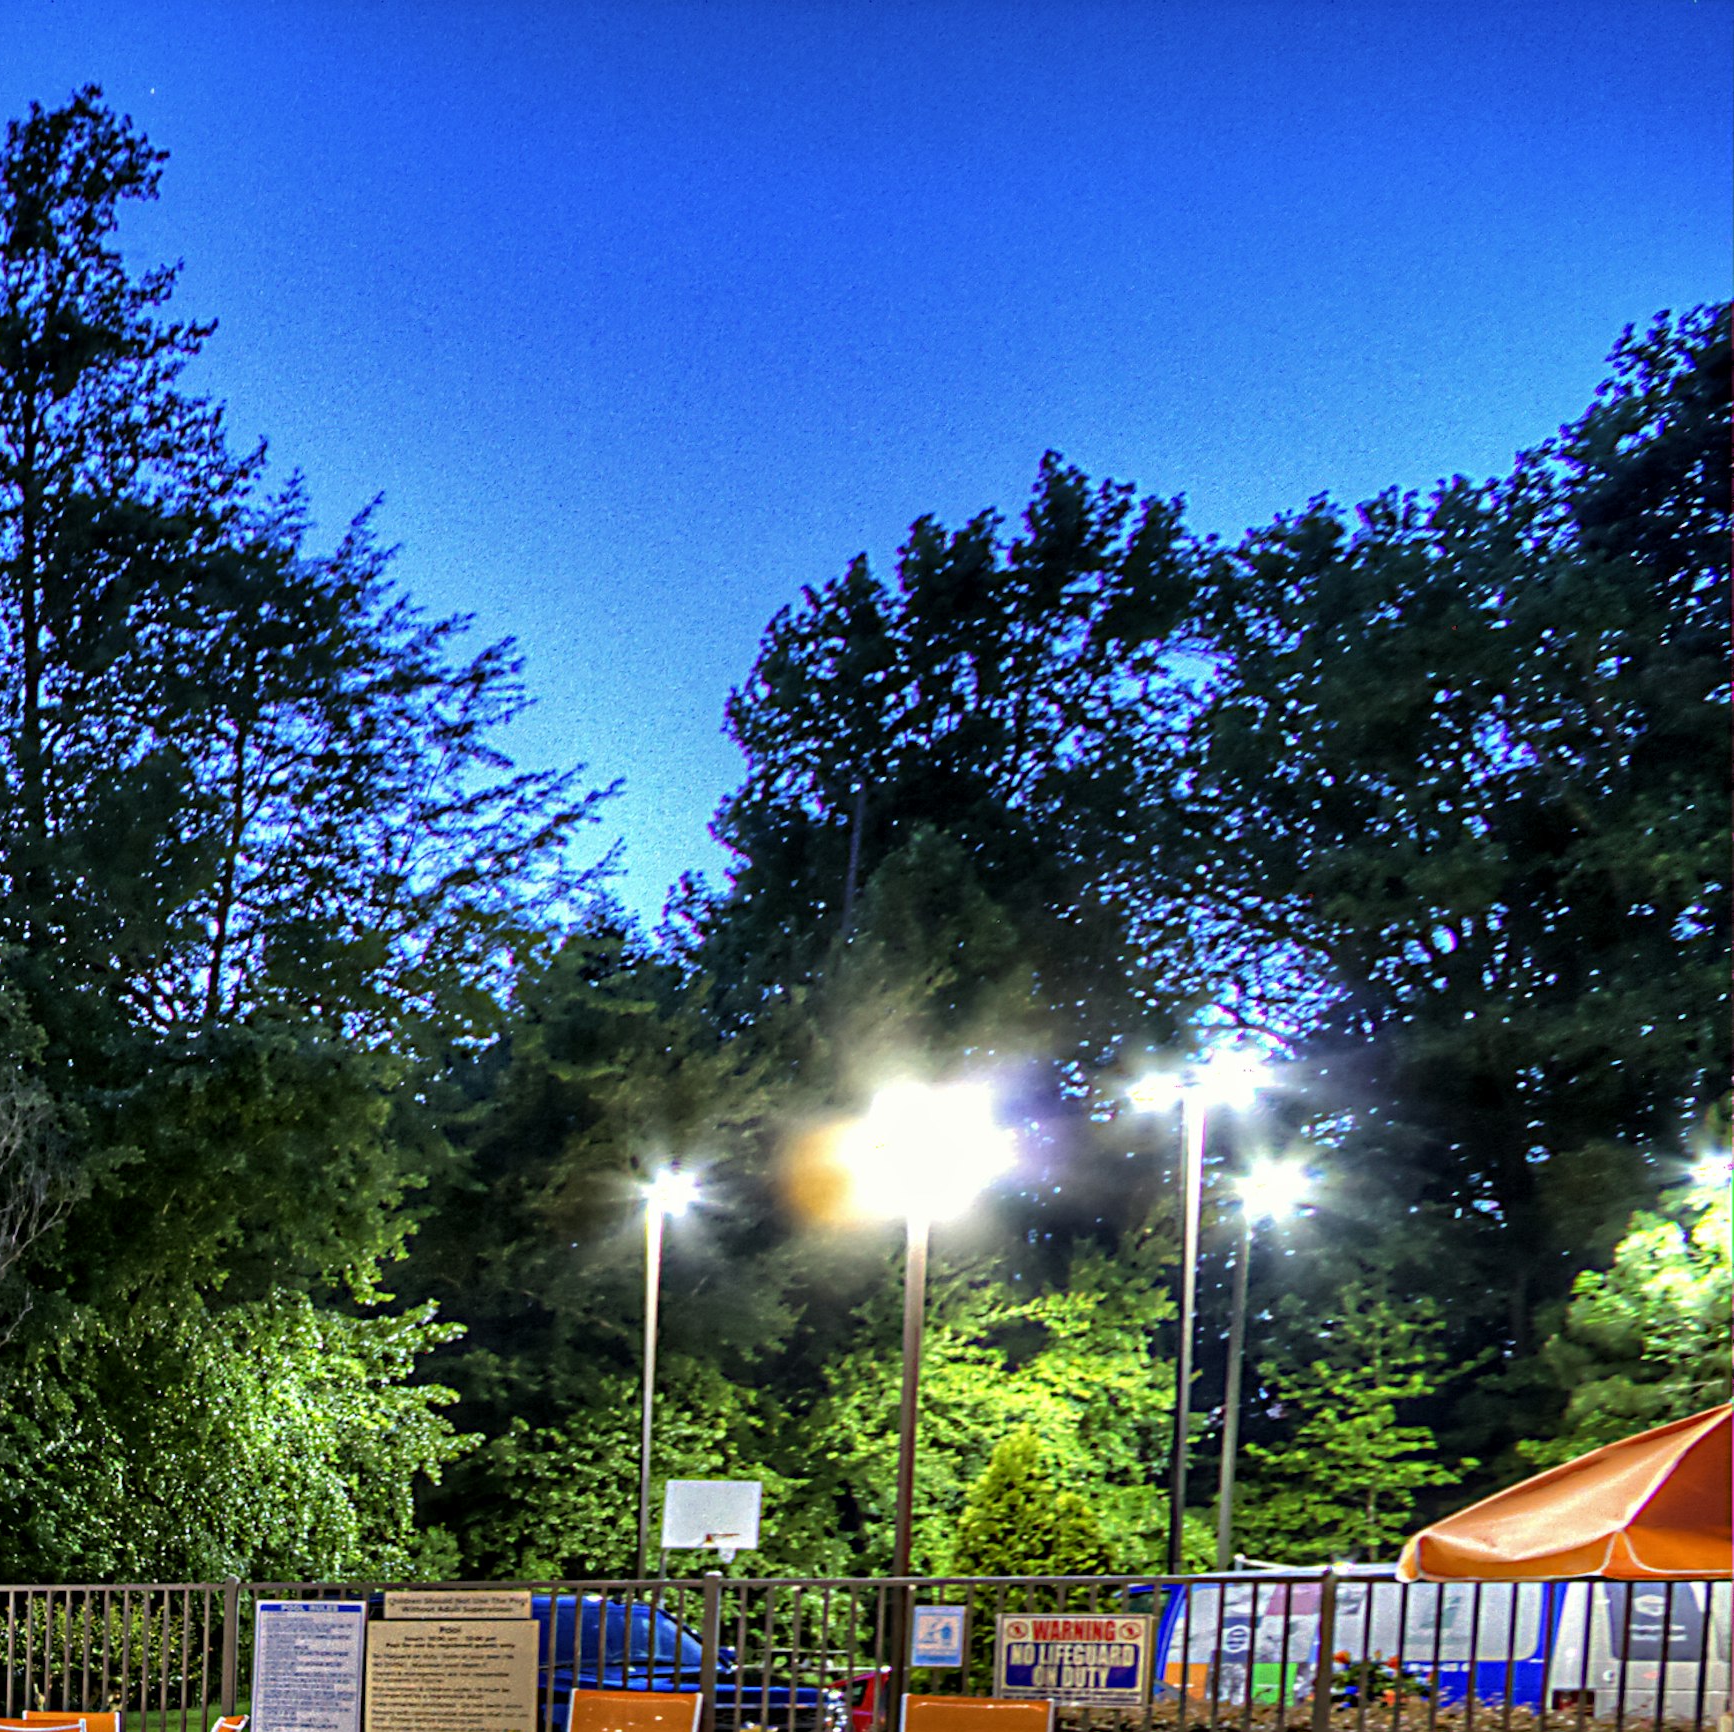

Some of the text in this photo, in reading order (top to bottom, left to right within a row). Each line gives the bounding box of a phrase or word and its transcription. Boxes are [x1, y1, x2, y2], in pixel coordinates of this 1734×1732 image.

[1033, 1620, 1116, 1641] WARNING
[1011, 1645, 1135, 1666] NO LIFEGUARD
[1034, 1666, 1111, 1687] ON DUTY
